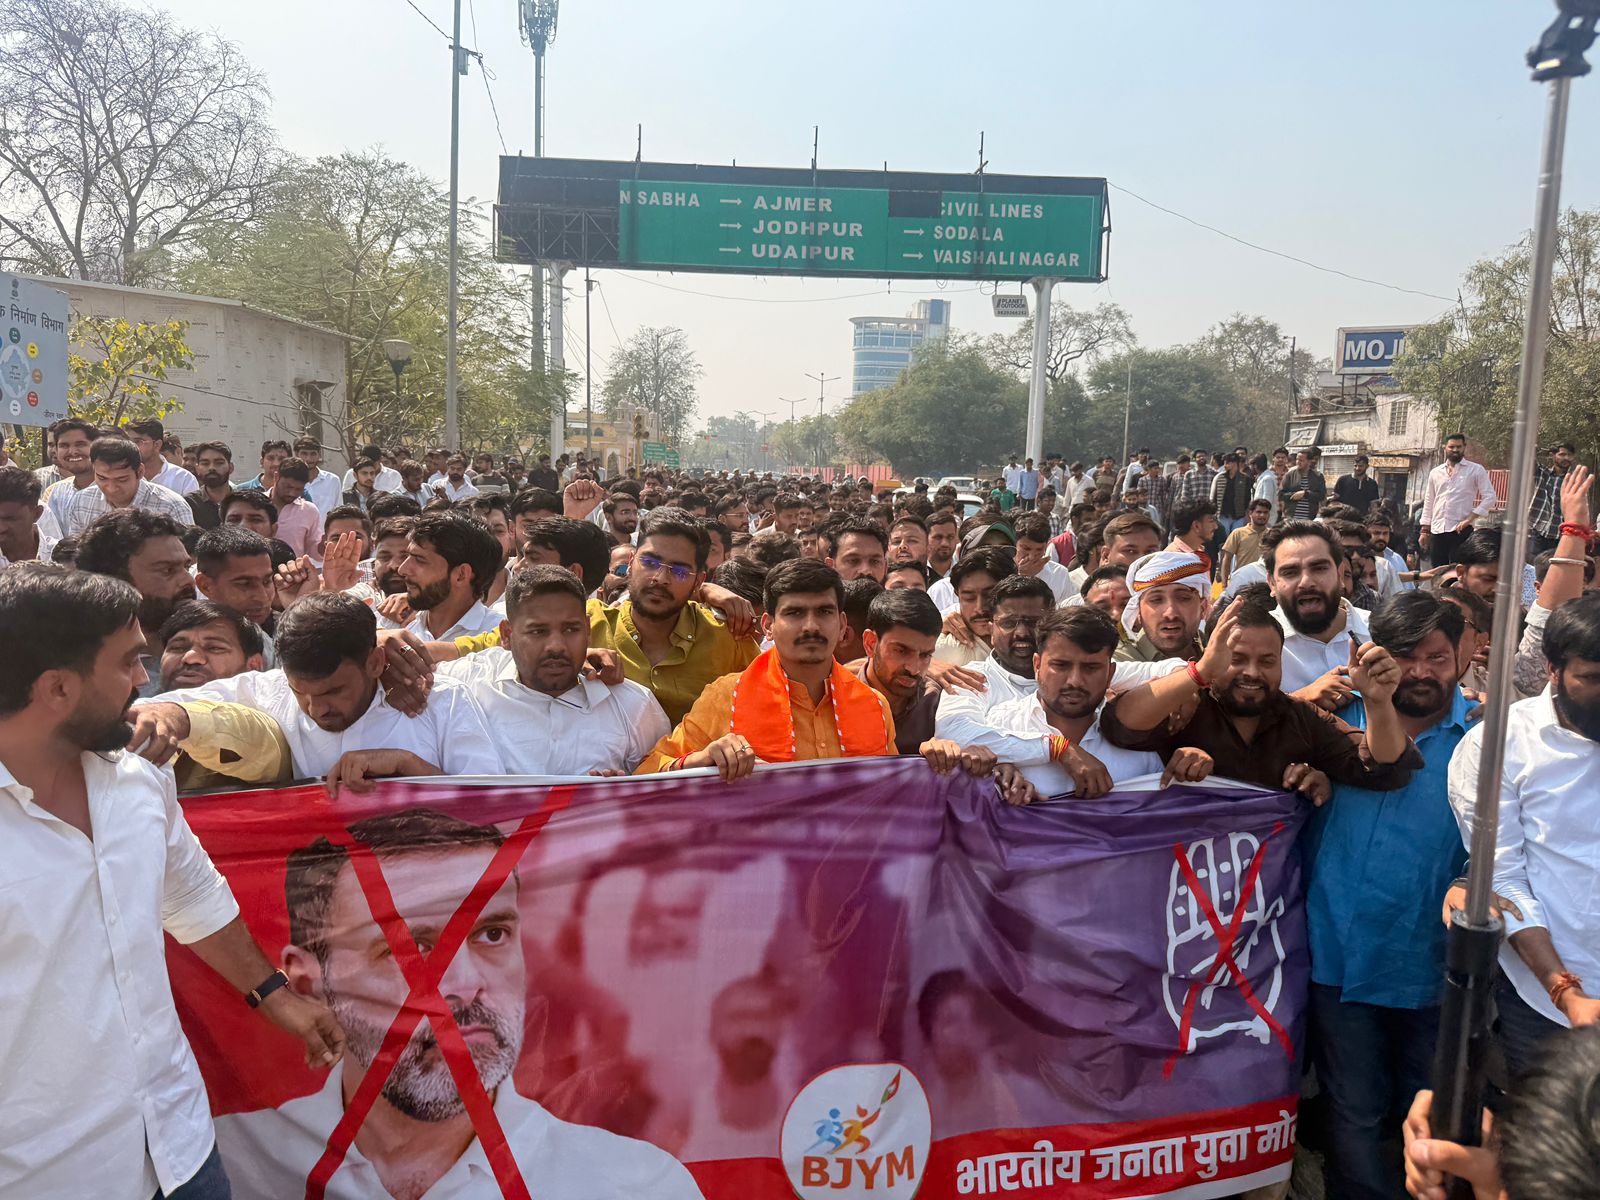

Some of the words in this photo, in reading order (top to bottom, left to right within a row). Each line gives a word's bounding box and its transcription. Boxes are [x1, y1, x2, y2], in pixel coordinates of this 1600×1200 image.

[637, 191, 700, 207] SABHA
[753, 195, 833, 212] AJMER
[989, 203, 1044, 219] LINES
[752, 219, 863, 237] JODHPUR
[934, 225, 1004, 242] SODALA
[751, 243, 855, 261] UDAIPUR
[933, 249, 1014, 265] VAISHALI
[1019, 252, 1080, 267] NAGAR
[10, 303, 37, 326] निर्माण
[41, 312, 64, 333] विभाग
[802, 1143, 916, 1190] BJYM
[956, 1139, 1085, 1195] भारतीय
[1090, 1136, 1187, 1181] जनता
[1191, 1126, 1252, 1179] युवा
